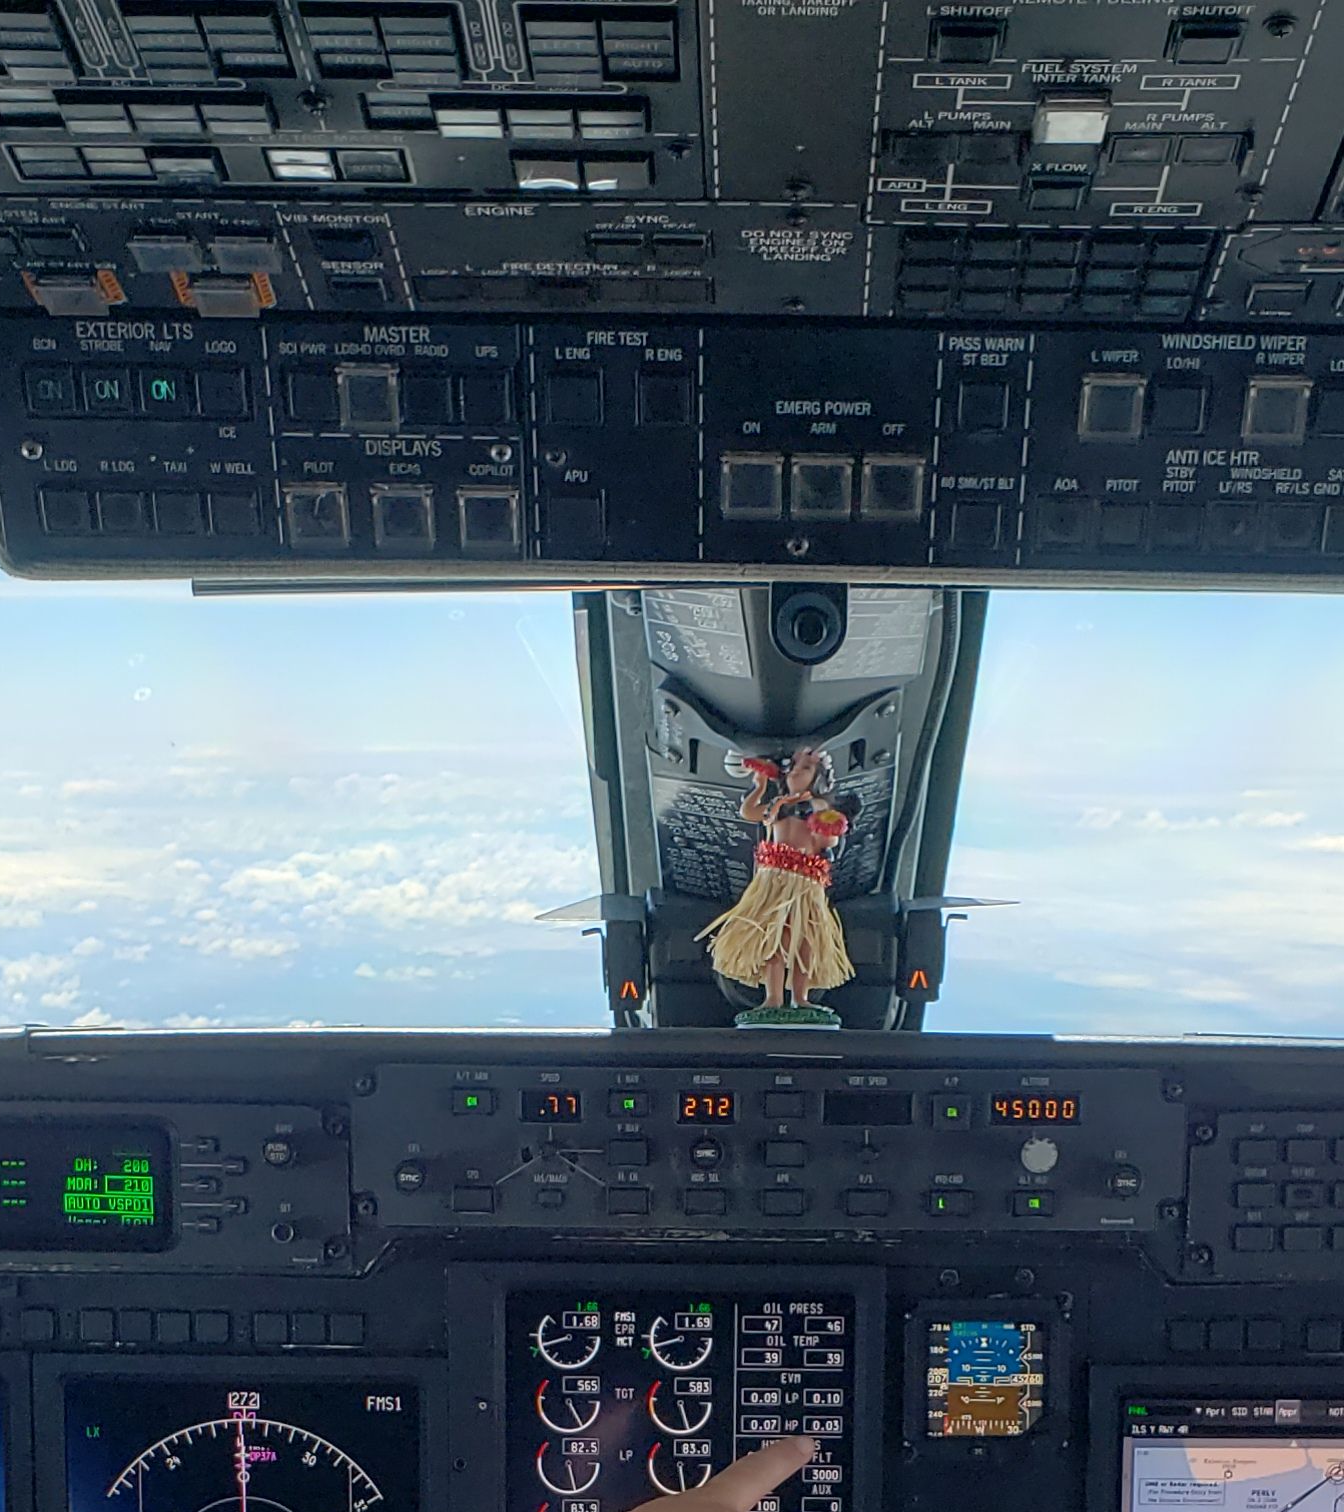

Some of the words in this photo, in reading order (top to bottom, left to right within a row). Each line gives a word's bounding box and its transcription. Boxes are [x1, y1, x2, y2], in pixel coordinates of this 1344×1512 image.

[1021, 63, 1058, 74] FUEL
[1070, 63, 1137, 74] SYSTEM
[949, 76, 988, 86] TANK
[1032, 73, 1078, 84] INTER
[1083, 73, 1122, 84] TANK
[1177, 77, 1218, 87] TANK
[888, 181, 918, 191] APU
[464, 206, 535, 217] ENGINE
[624, 215, 670, 224] SYNC
[76, 321, 156, 340] EXTERIOR
[163, 323, 194, 340] LTS
[364, 326, 431, 344] MASTER
[80, 340, 125, 351] STROBE
[587, 331, 616, 346] FIRE
[619, 332, 649, 347] TEST
[949, 337, 981, 351] PASS
[984, 337, 1025, 352] WARN
[1162, 334, 1256, 351] WINDSHIELD
[1259, 335, 1307, 352] WIPER
[150, 341, 172, 352] NAV
[206, 341, 237, 354] LOGO
[279, 342, 297, 355] SCI
[301, 343, 326, 356] PWR
[375, 344, 405, 357] OVRD
[415, 344, 449, 358] RADIO
[476, 346, 498, 359] UPS
[564, 348, 591, 361] ENG
[645, 349, 654, 362] R
[657, 349, 683, 362] ENG
[963, 353, 978, 366] ST
[980, 353, 1009, 367] BELT
[1102, 350, 1139, 363] WIPER
[1256, 352, 1266, 365] R
[1269, 352, 1306, 366] WIPER
[1167, 356, 1200, 370] LO/HI
[95, 380, 120, 400] ON
[151, 380, 176, 400] ON
[776, 401, 821, 416] EMERG
[825, 401, 872, 416] POWER
[219, 426, 237, 438] ICE
[743, 421, 761, 434] ON
[810, 421, 836, 435] ARM
[882, 423, 905, 436] OFF
[366, 440, 442, 457] DISPLAYS
[1165, 450, 1198, 466] ANTI
[1202, 451, 1226, 467] ICE
[1229, 451, 1259, 467] HTR
[164, 461, 187, 473] TAXI
[210, 463, 222, 474] W
[225, 463, 255, 475] WELL
[303, 461, 334, 474] PILOT
[469, 463, 514, 477] COPILOT
[1166, 467, 1195, 479] STBY
[564, 469, 588, 483] APU
[1231, 468, 1302, 481] WINDSHIELD
[1054, 478, 1078, 491] AOA
[1106, 479, 1139, 492] PITOT
[1163, 480, 1196, 493] PITOT
[1219, 481, 1253, 494] LF/RS
[1275, 482, 1310, 495] RF/LS
[1313, 483, 1340, 496] GND
[539, 1096, 577, 1115] .77
[684, 1098, 730, 1117] 272
[995, 1100, 1075, 1119] 45000
[75, 1158, 97, 1172] DH:
[123, 1159, 149, 1173] 200
[67, 1177, 98, 1191] MDA:
[124, 1179, 149, 1192] 210
[68, 1197, 101, 1211] AUTO
[108, 1198, 150, 1212] VSPD1
[763, 1303, 783, 1314] OIL
[789, 1303, 824, 1314] PRESS
[571, 1315, 598, 1327] 1.68
[614, 1311, 636, 1322] FMS1
[684, 1316, 711, 1328] 1.69
[614, 1324, 635, 1335] EPR
[766, 1336, 786, 1347] OIL
[793, 1336, 820, 1347] TEMP
[764, 1353, 779, 1364] 39
[826, 1353, 841, 1364] 39
[577, 1379, 599, 1391] 565
[781, 1373, 801, 1384] EVM
[688, 1381, 710, 1392] 583
[231, 1392, 258, 1406] 272
[614, 1388, 635, 1399] TGT
[750, 1392, 778, 1404] 0.09
[785, 1393, 799, 1404] LP
[813, 1393, 841, 1404] 0.10
[366, 1396, 402, 1411] FMS1
[750, 1420, 777, 1431] 0.07
[785, 1421, 799, 1431] HP
[812, 1421, 840, 1432] 0.03
[570, 1442, 598, 1453] 82.5
[682, 1443, 709, 1455] 83.0
[812, 1469, 839, 1480] 3000
[811, 1484, 832, 1495] AUX
